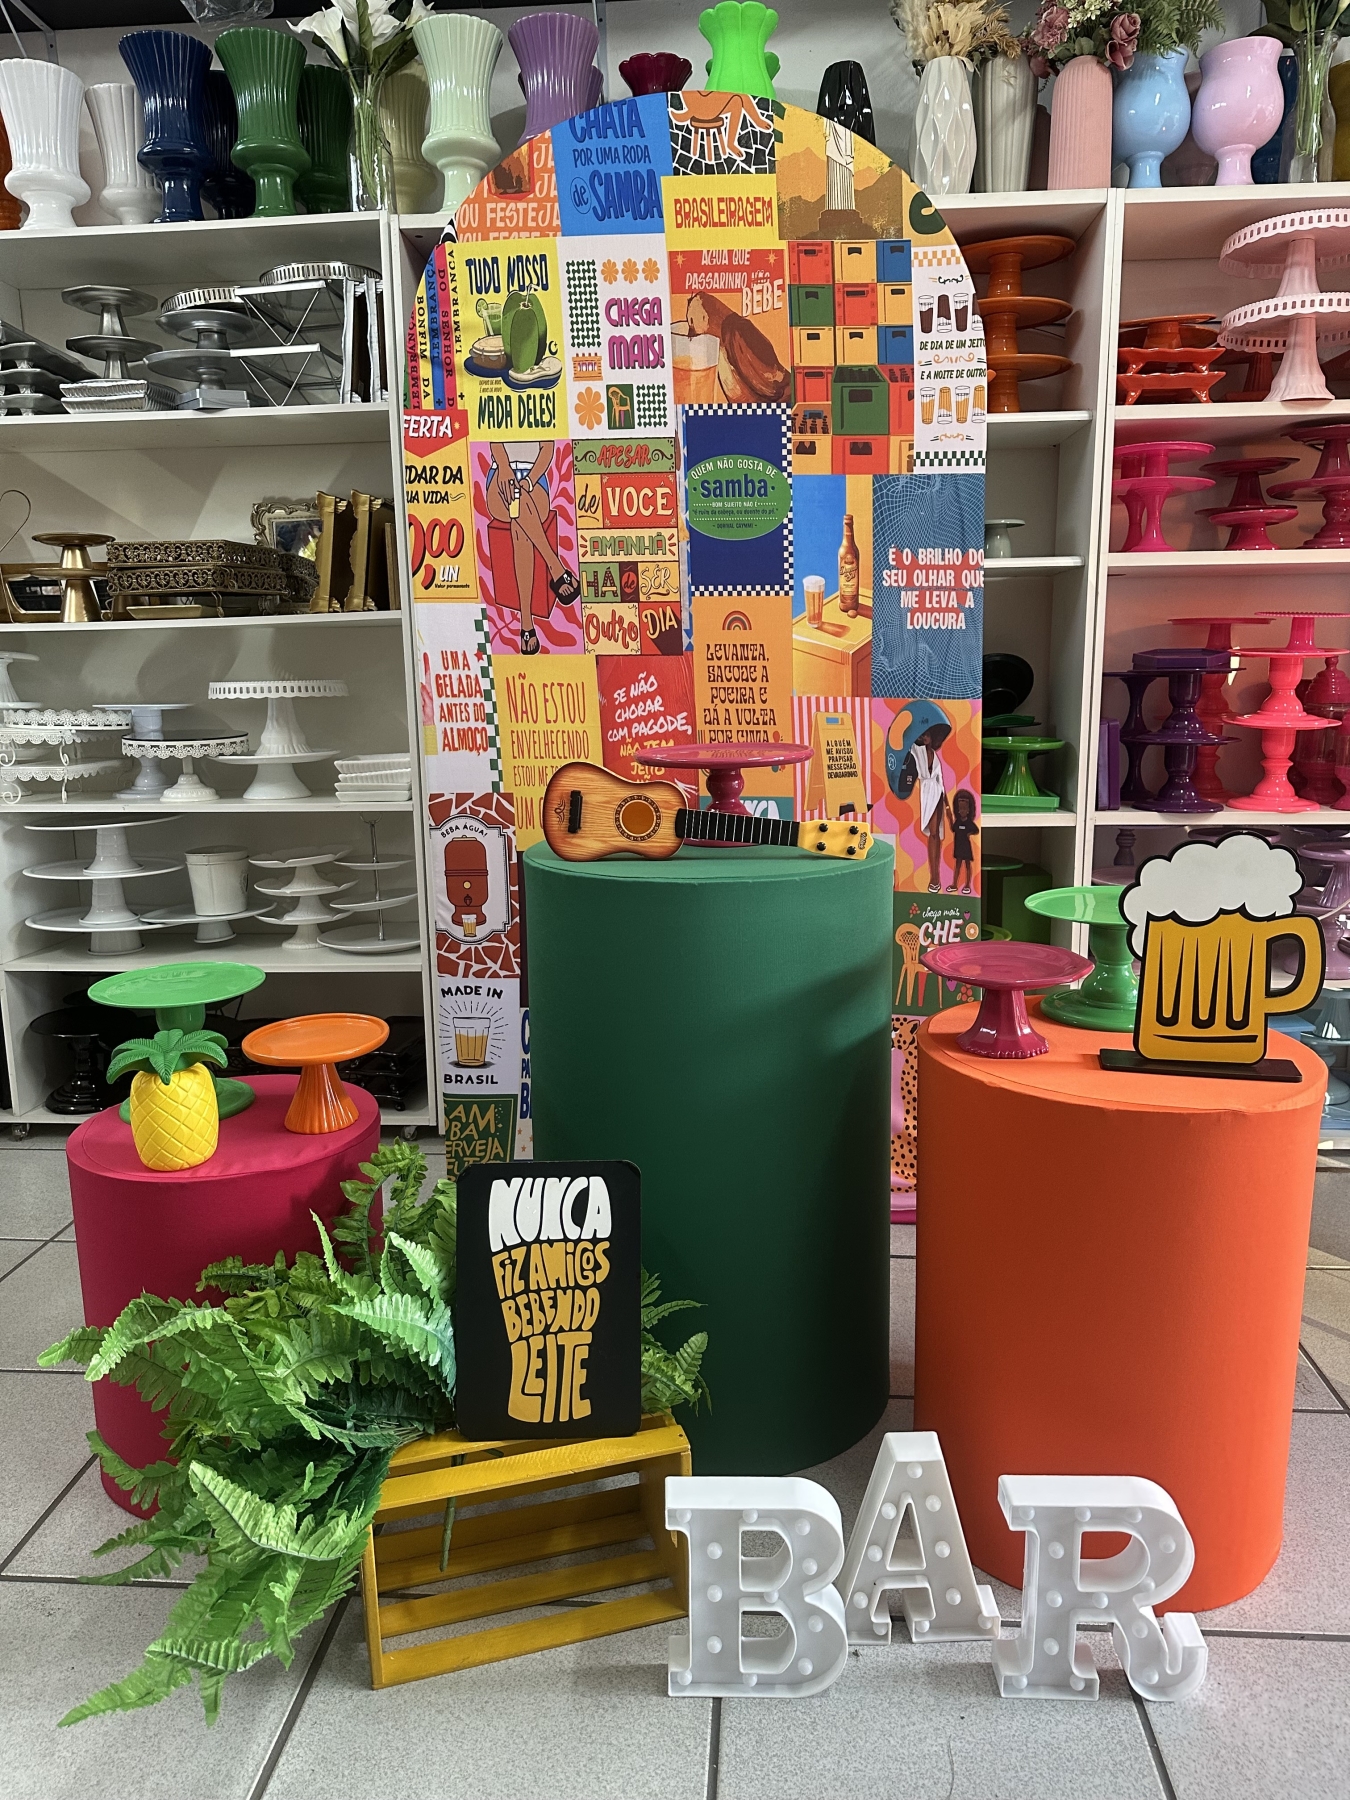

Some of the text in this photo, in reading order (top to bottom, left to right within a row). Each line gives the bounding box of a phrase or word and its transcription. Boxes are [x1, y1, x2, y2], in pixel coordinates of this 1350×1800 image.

[568, 98, 645, 143] CHATA
[572, 148, 594, 168] POR
[597, 146, 621, 165] UMA
[623, 144, 652, 164] RODA
[572, 183, 590, 206] de
[588, 168, 665, 222] SAMBA
[674, 196, 773, 228] BRASILEIRAGEM
[732, 249, 751, 265] QUE
[438, 268, 447, 292] DO
[465, 253, 549, 296] TUDO NOSSO
[685, 271, 748, 290] PASSARINHO
[742, 278, 783, 317] BEBE
[605, 296, 663, 328] CHEGA
[416, 295, 431, 400] BONFIM DA
[441, 310, 454, 378] SENHOR
[608, 334, 665, 370] MAIS!
[919, 340, 929, 351] DE
[930, 340, 943, 350] DIA
[945, 339, 955, 350] DE
[956, 338, 967, 349] UM
[920, 370, 926, 380] E
[926, 370, 932, 380] A
[932, 369, 955, 380] NOITE
[955, 369, 966, 379] DE
[478, 391, 556, 430] NADA DELES!
[597, 444, 651, 468] APESAR
[442, 466, 464, 485] DA
[691, 457, 777, 480] QUEM NÃO GOSTA DE
[423, 491, 450, 505] VIDA
[700, 473, 768, 499] samba
[578, 481, 674, 517] de VOCÊ
[743, 499, 753, 508] NÃO
[589, 532, 666, 557] AMANHÃ
[888, 544, 896, 565] É
[902, 548, 912, 565] O
[918, 548, 962, 566] BRILHO
[440, 565, 460, 583] UN
[582, 566, 619, 598] HÁ
[623, 574, 636, 590] de
[882, 569, 907, 587] SEU
[913, 569, 955, 587] OLHAR
[900, 590, 919, 608] ME
[925, 590, 958, 608] LEVA
[585, 605, 678, 649] Outro DIA
[907, 612, 966, 630] LOUCURA
[441, 651, 471, 671] UMA
[706, 643, 770, 663] LEVANTA,
[435, 673, 484, 698] GELADA
[707, 665, 769, 683] SACODE A
[506, 672, 586, 725] NÃO ESTOU
[613, 671, 658, 705] SE NÃO
[710, 687, 768, 705] POEIRA E
[439, 702, 486, 723] ANTES DO
[615, 695, 665, 723] CHORAR
[724, 708, 732, 726] A
[736, 708, 777, 726] VOLTA
[607, 711, 692, 742] COM PAGODE,
[709, 730, 733, 744] POR
[442, 727, 489, 756] ALMOÇO
[510, 729, 590, 760] ENVELHECENDO
[514, 765, 536, 788] ESTOU
[515, 796, 535, 830] UM
[440, 822, 488, 839] BEBA ÁGUA!
[922, 906, 960, 923] chega mais
[441, 985, 504, 1000] MADE IN
[443, 1073, 498, 1085] BRASIL
[488, 1176, 612, 1252] NUNCA
[501, 1287, 600, 1343] BEBENDO
[507, 1331, 593, 1424] LEITE
[665, 1431, 1208, 1701] BAR
